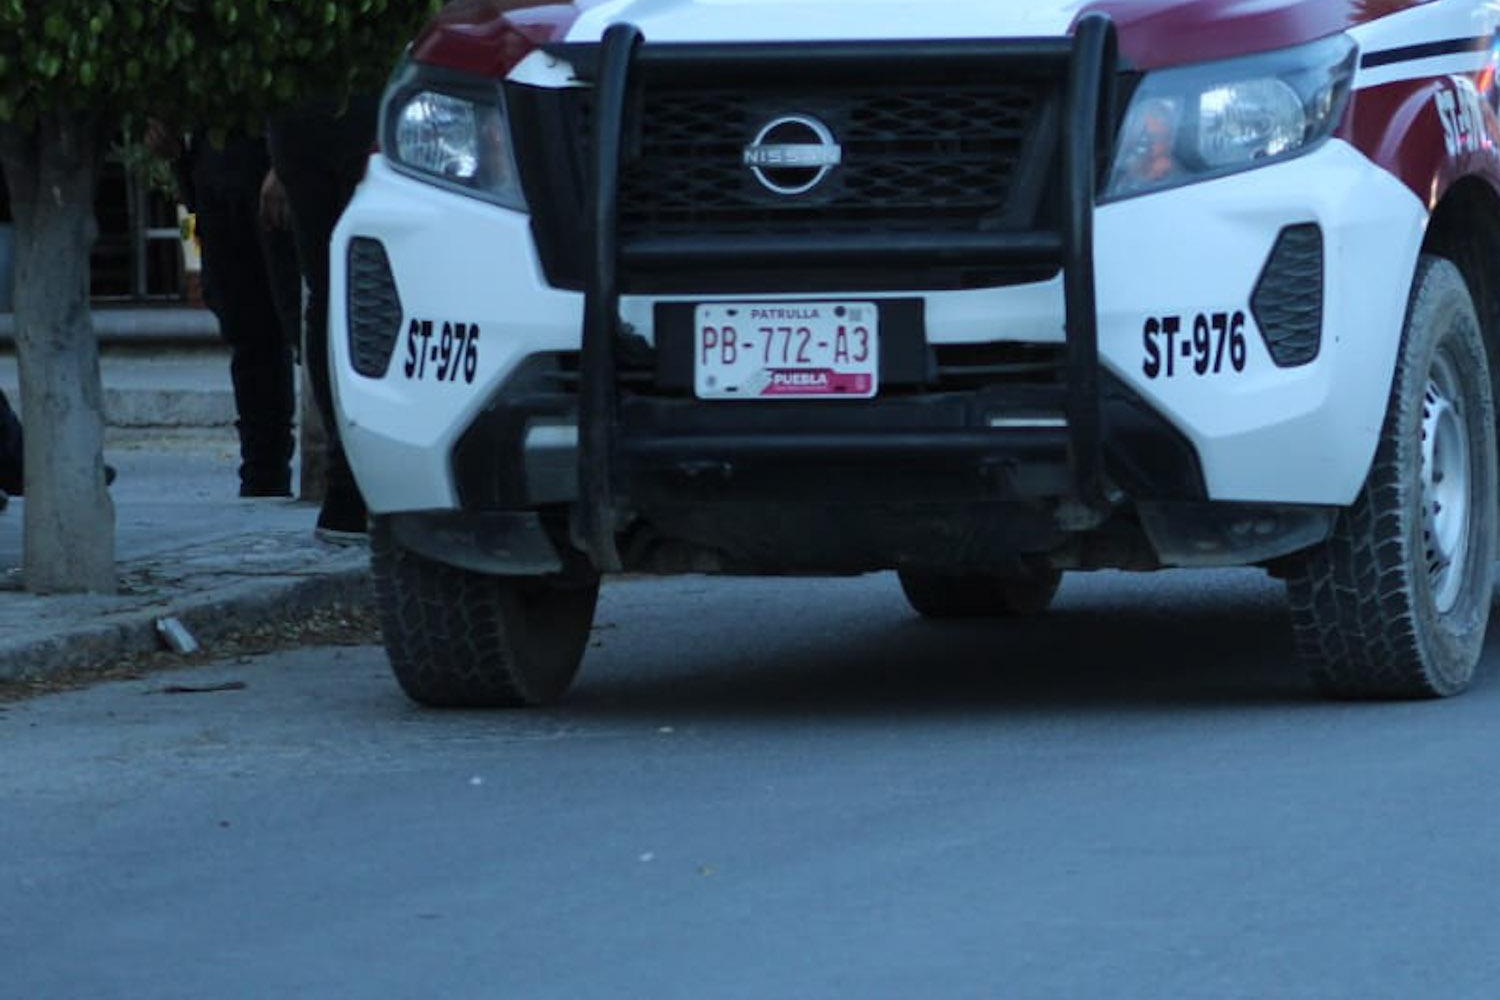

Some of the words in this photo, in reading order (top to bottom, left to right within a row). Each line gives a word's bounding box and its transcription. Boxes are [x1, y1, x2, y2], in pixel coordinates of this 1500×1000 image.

[750, 308, 820, 320] PATRULLA
[404, 318, 479, 384] ST-976
[702, 325, 869, 365] PB-772-A3
[1142, 310, 1246, 379] ST-976
[773, 373, 827, 386] PUEBLA
